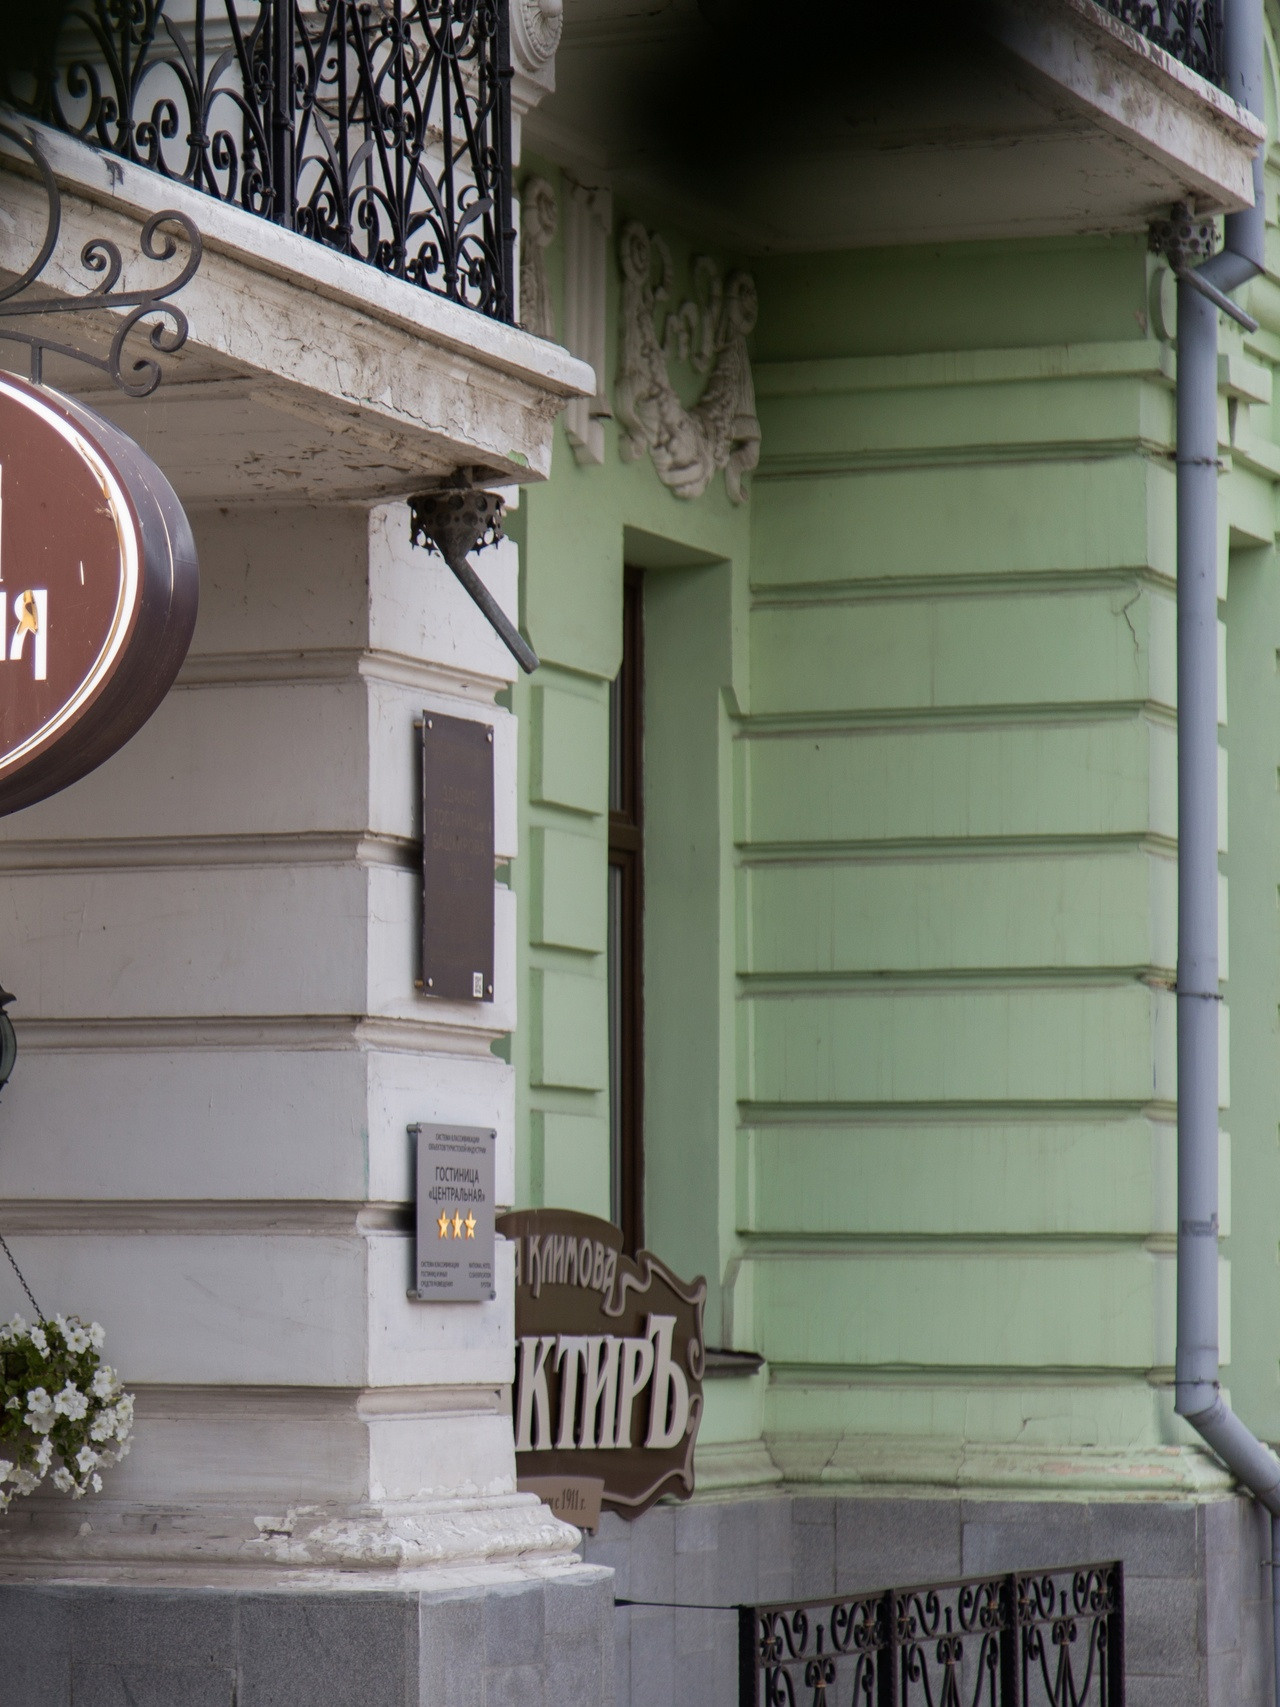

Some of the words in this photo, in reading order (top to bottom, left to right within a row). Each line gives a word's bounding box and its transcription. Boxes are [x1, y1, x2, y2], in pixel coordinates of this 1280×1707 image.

[435, 1166, 480, 1187] ГОСТИНИЦА
[515, 1313, 689, 1452] КТИРЪ
[562, 1488, 580, 1511] 1911
